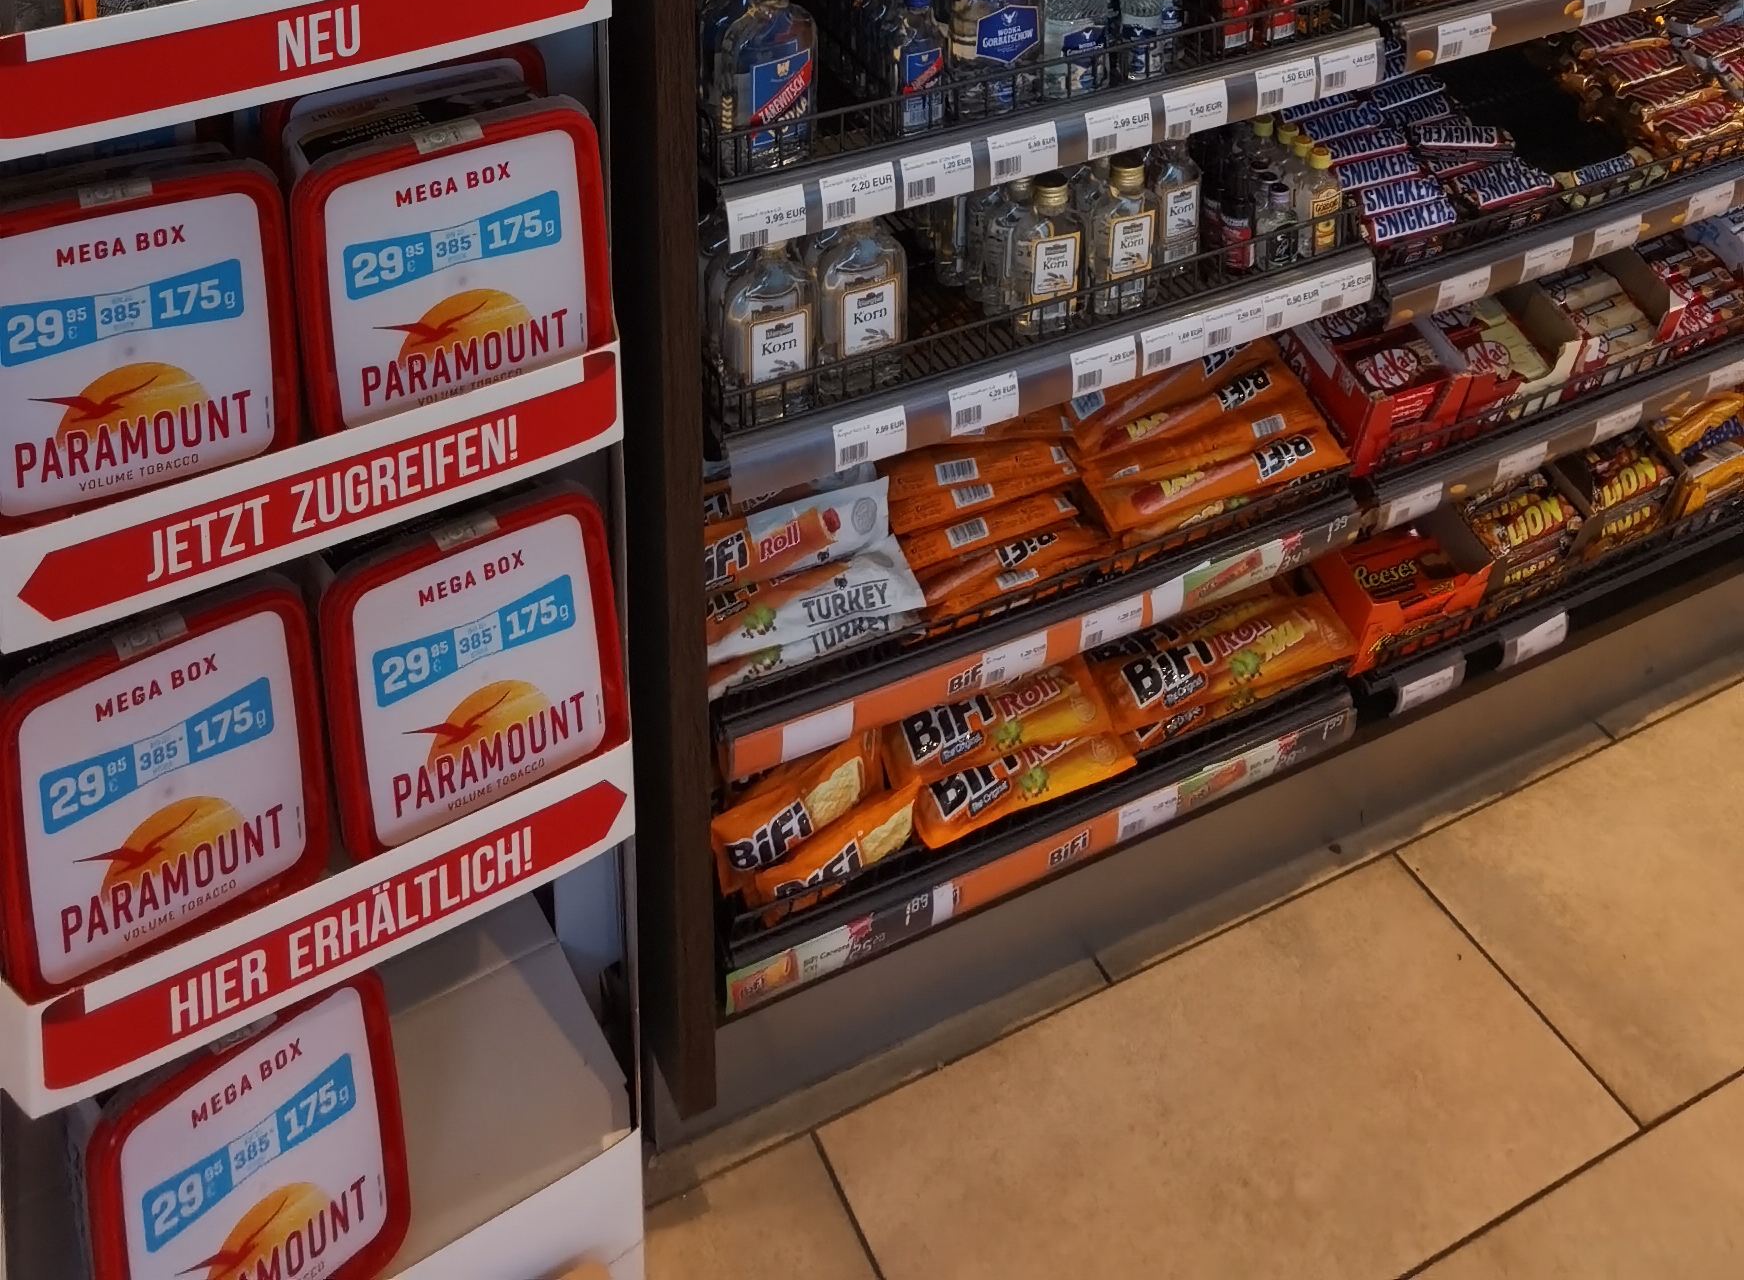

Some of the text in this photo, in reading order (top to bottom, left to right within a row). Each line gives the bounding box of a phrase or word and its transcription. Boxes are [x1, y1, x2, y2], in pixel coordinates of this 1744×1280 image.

[277, 4, 362, 72] NEU
[1302, 102, 1383, 143] SNICKERS
[1327, 127, 1405, 160] SNICKERS
[395, 161, 512, 207] MEGA BOX
[872, 173, 893, 188] EUR
[1575, 153, 1635, 186] SNICKERS
[786, 207, 807, 220] EUR
[1374, 201, 1456, 241] SNICKERS
[55, 223, 187, 269] MEGA BOX
[1119, 236, 1144, 250] Korn
[351, 244, 404, 289] 29
[6, 308, 66, 355] 29
[853, 305, 888, 326] Korn
[360, 308, 570, 408] PARAMOUNT
[761, 338, 798, 357] Korn
[1366, 347, 1419, 390] KitKat
[14, 388, 252, 490] PARAMOUNT
[78, 452, 201, 492] VOLUME TOBACCO
[1600, 456, 1658, 509] LION
[146, 414, 519, 583] JETZT ZUGREIFEN!
[1506, 496, 1564, 547] LION
[759, 519, 801, 563] Roll
[418, 549, 526, 607] MEGA BOX
[1353, 556, 1419, 589] Reese's
[802, 583, 889, 623] TURKEY
[95, 652, 220, 723] MEGA BOX
[380, 652, 431, 694] 29
[392, 690, 588, 819] PARAMOUNT
[48, 771, 107, 822] 29
[446, 757, 546, 813] VOLUME TOBACCO
[60, 803, 285, 954] PARAMOUNT
[123, 878, 238, 942] VOLUME TOBACCO
[170, 825, 534, 1035] HIER ERHÄLTLICH!
[191, 1037, 305, 1130] MEGA BOX
